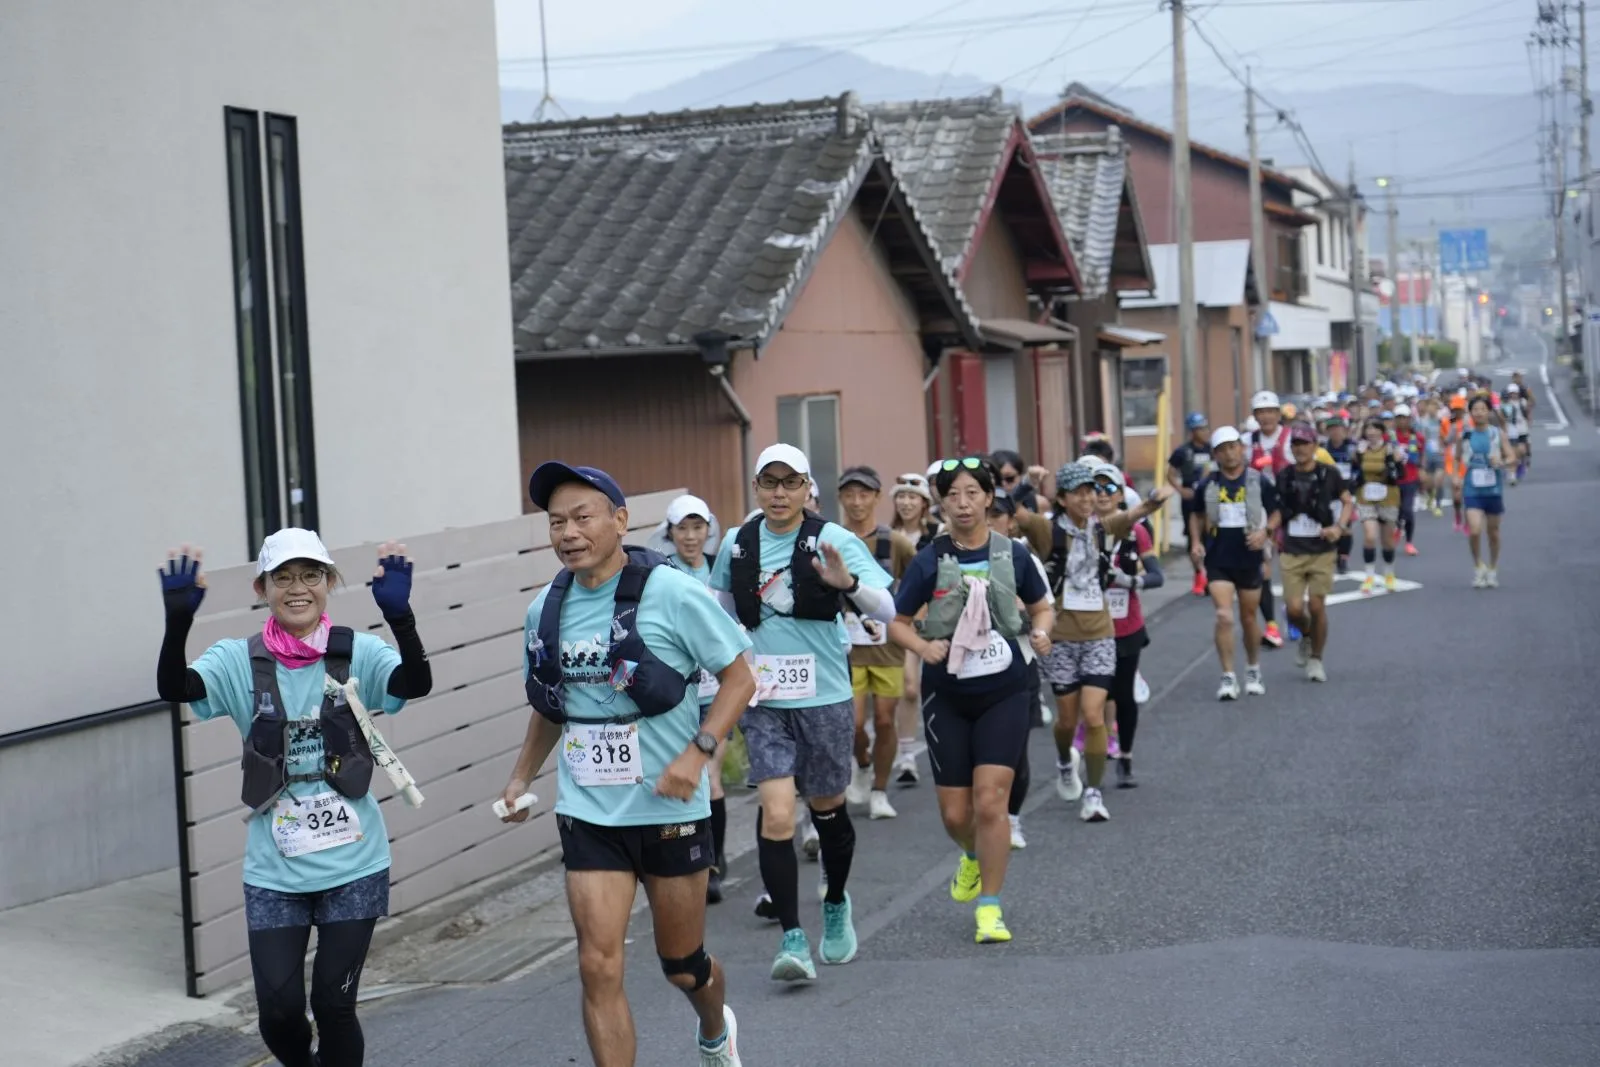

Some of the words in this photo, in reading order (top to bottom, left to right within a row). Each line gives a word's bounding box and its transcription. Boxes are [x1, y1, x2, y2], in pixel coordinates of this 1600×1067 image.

[980, 641, 1004, 660] 287
[778, 668, 809, 684] 339
[599, 730, 632, 741] 高砂熱学
[592, 744, 632, 764] 318
[306, 805, 350, 831] 324
